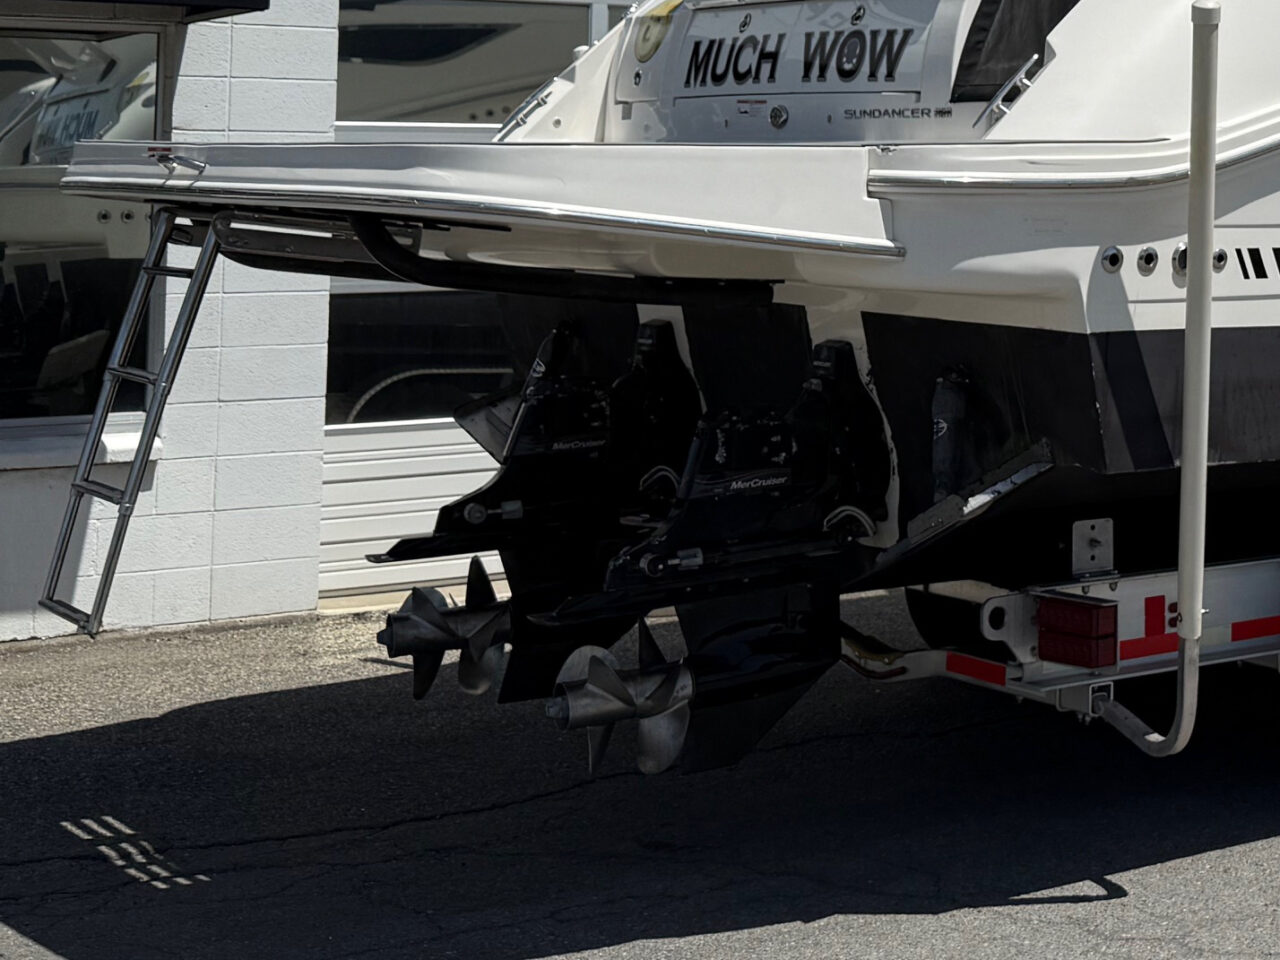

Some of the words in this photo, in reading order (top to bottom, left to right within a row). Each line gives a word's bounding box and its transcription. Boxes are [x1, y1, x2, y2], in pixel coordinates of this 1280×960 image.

[684, 33, 786, 88] MUCH
[801, 28, 914, 83] WOW
[843, 107, 932, 120] SUNDANCER
[730, 477, 788, 489] MerCruiser
